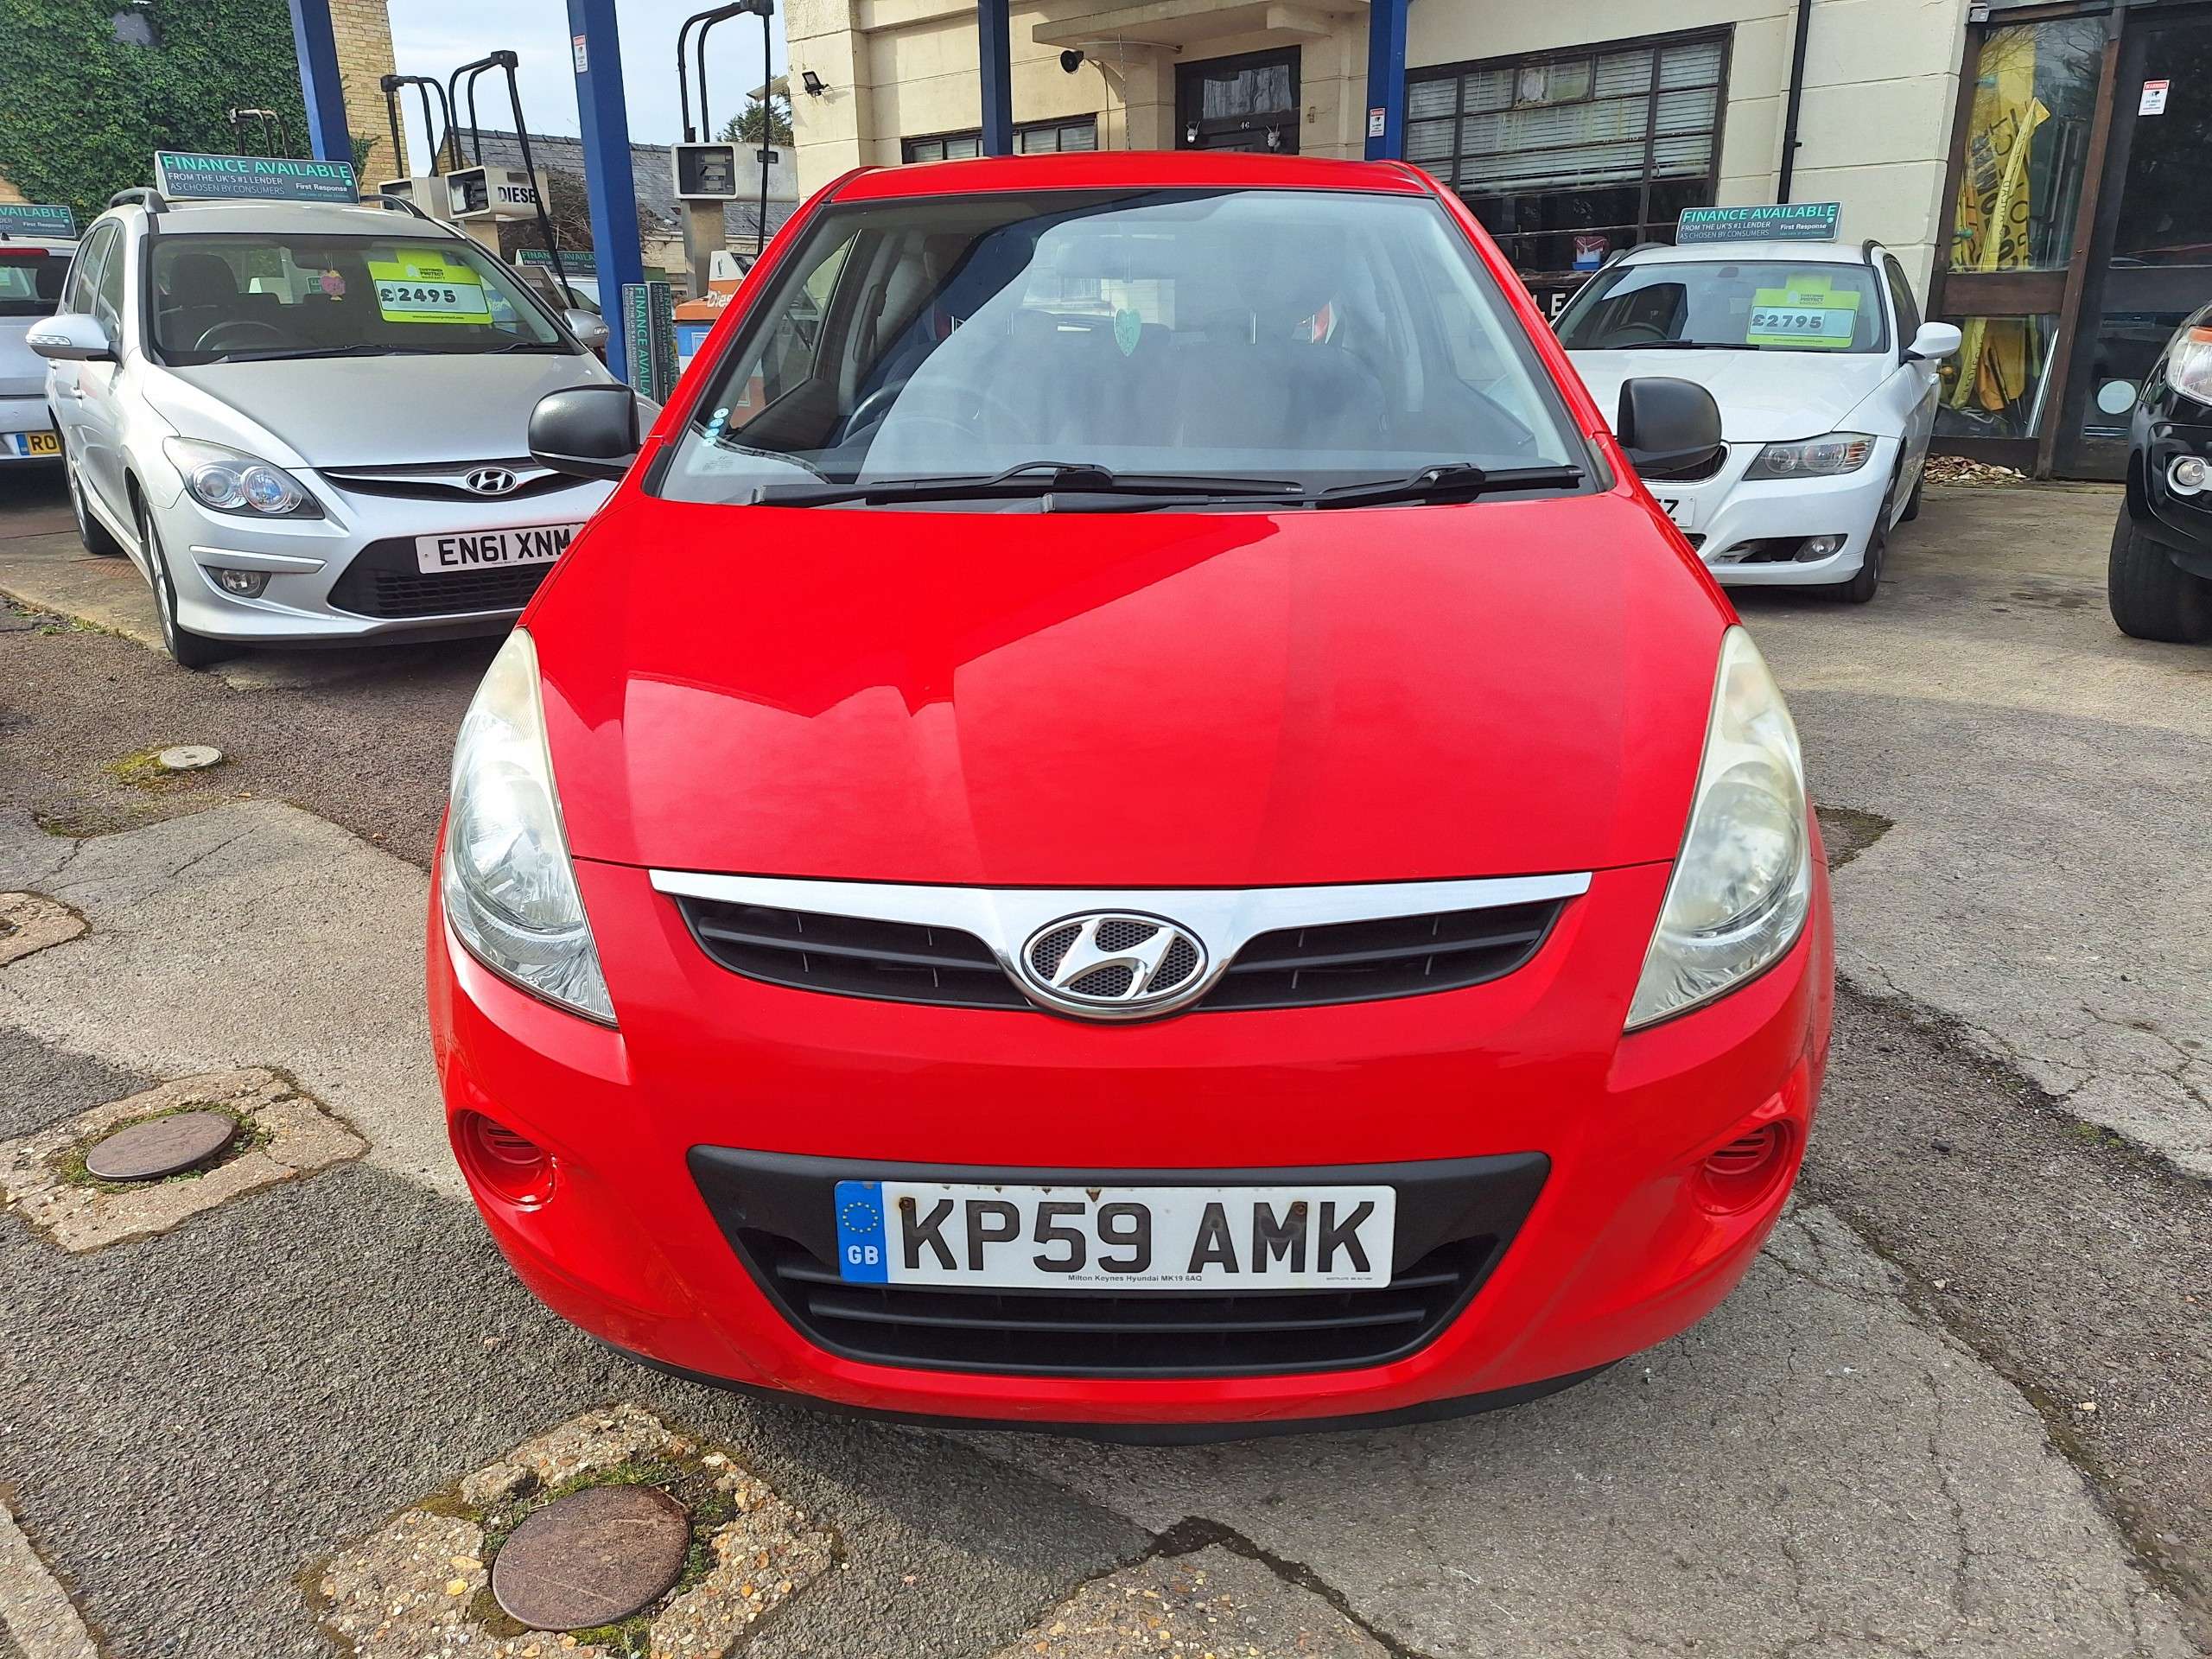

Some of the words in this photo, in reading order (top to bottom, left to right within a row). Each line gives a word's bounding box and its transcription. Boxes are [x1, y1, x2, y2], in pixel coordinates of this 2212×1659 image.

[162, 156, 249, 172] FINANCE
[255, 161, 351, 179] AVAILABLE
[168, 173, 194, 181] FROM
[197, 174, 213, 182] THE
[216, 175, 236, 183] UK'S
[238, 175, 248, 184] #1
[250, 176, 283, 185] LENDER
[183, 183, 220, 192] CHOSEN
[233, 186, 285, 194] CONSUMERS
[314, 183, 347, 193] Response
[0, 207, 69, 219] VAILABLE
[1682, 208, 1747, 223] FINANCE
[1751, 205, 1837, 219] AVAILABLE
[1727, 229, 1770, 238] CONSUMERS
[380, 288, 456, 303] £2495
[635, 287, 648, 346] FINANCE
[1752, 314, 1822, 328] £2795
[638, 349, 651, 397] AVAILA
[437, 535, 508, 566] EN61
[899, 1197, 1152, 1274] KP59
[1187, 1201, 1376, 1274] AMK
[848, 1245, 880, 1266] GB
